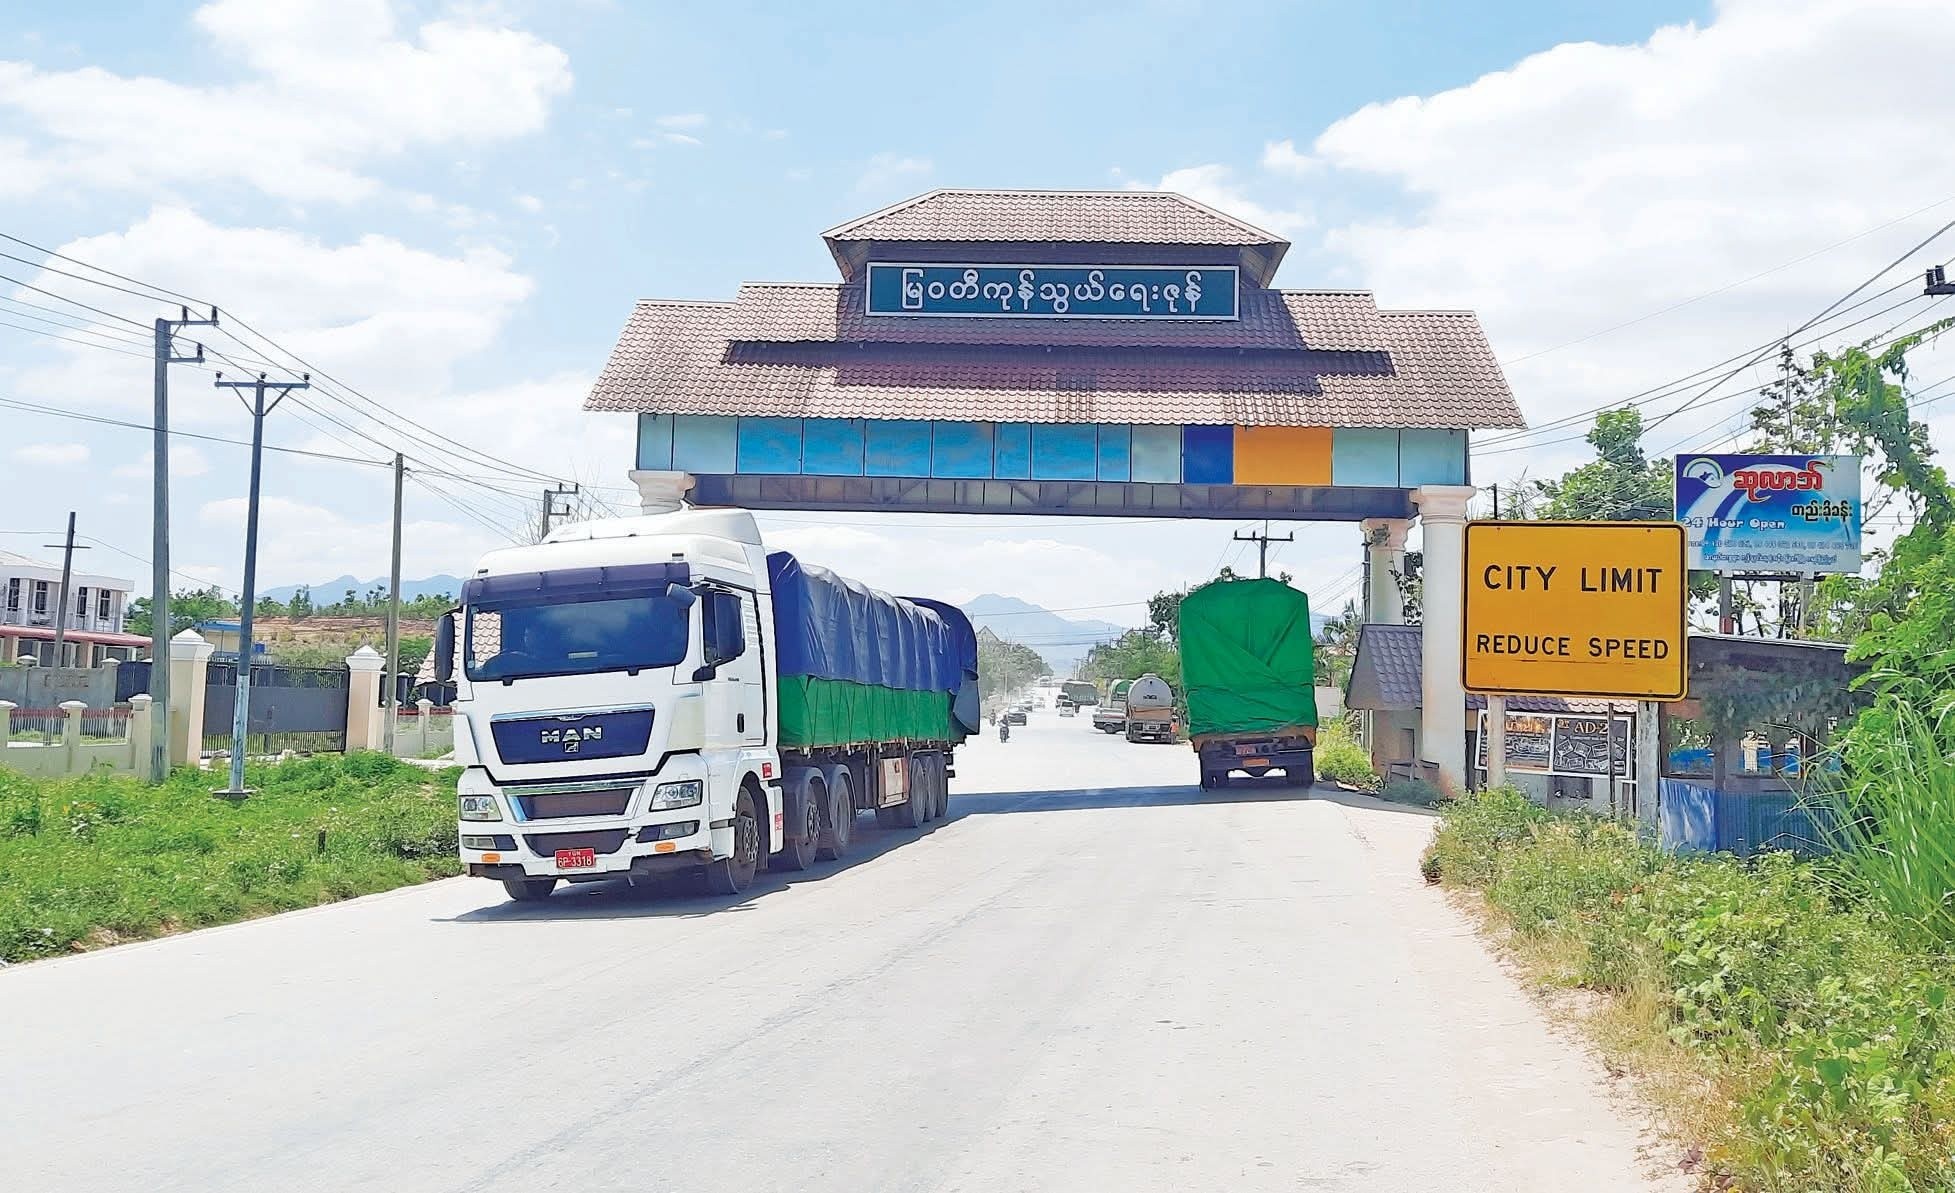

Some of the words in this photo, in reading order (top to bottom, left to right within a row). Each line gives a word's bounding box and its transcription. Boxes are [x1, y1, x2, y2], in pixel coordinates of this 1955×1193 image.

[902, 267, 1203, 314] မြဝတီကုန်သွယ်ရေးဇုန်
[1682, 516, 1704, 528] 24
[1707, 516, 1744, 529] Hour
[1749, 518, 1786, 532] Open
[1483, 564, 1557, 591] CITY
[1581, 567, 1663, 593] LIMIT
[1476, 634, 1571, 656] REDUCE
[1588, 637, 1669, 660] SPEED
[541, 727, 602, 744] MAN
